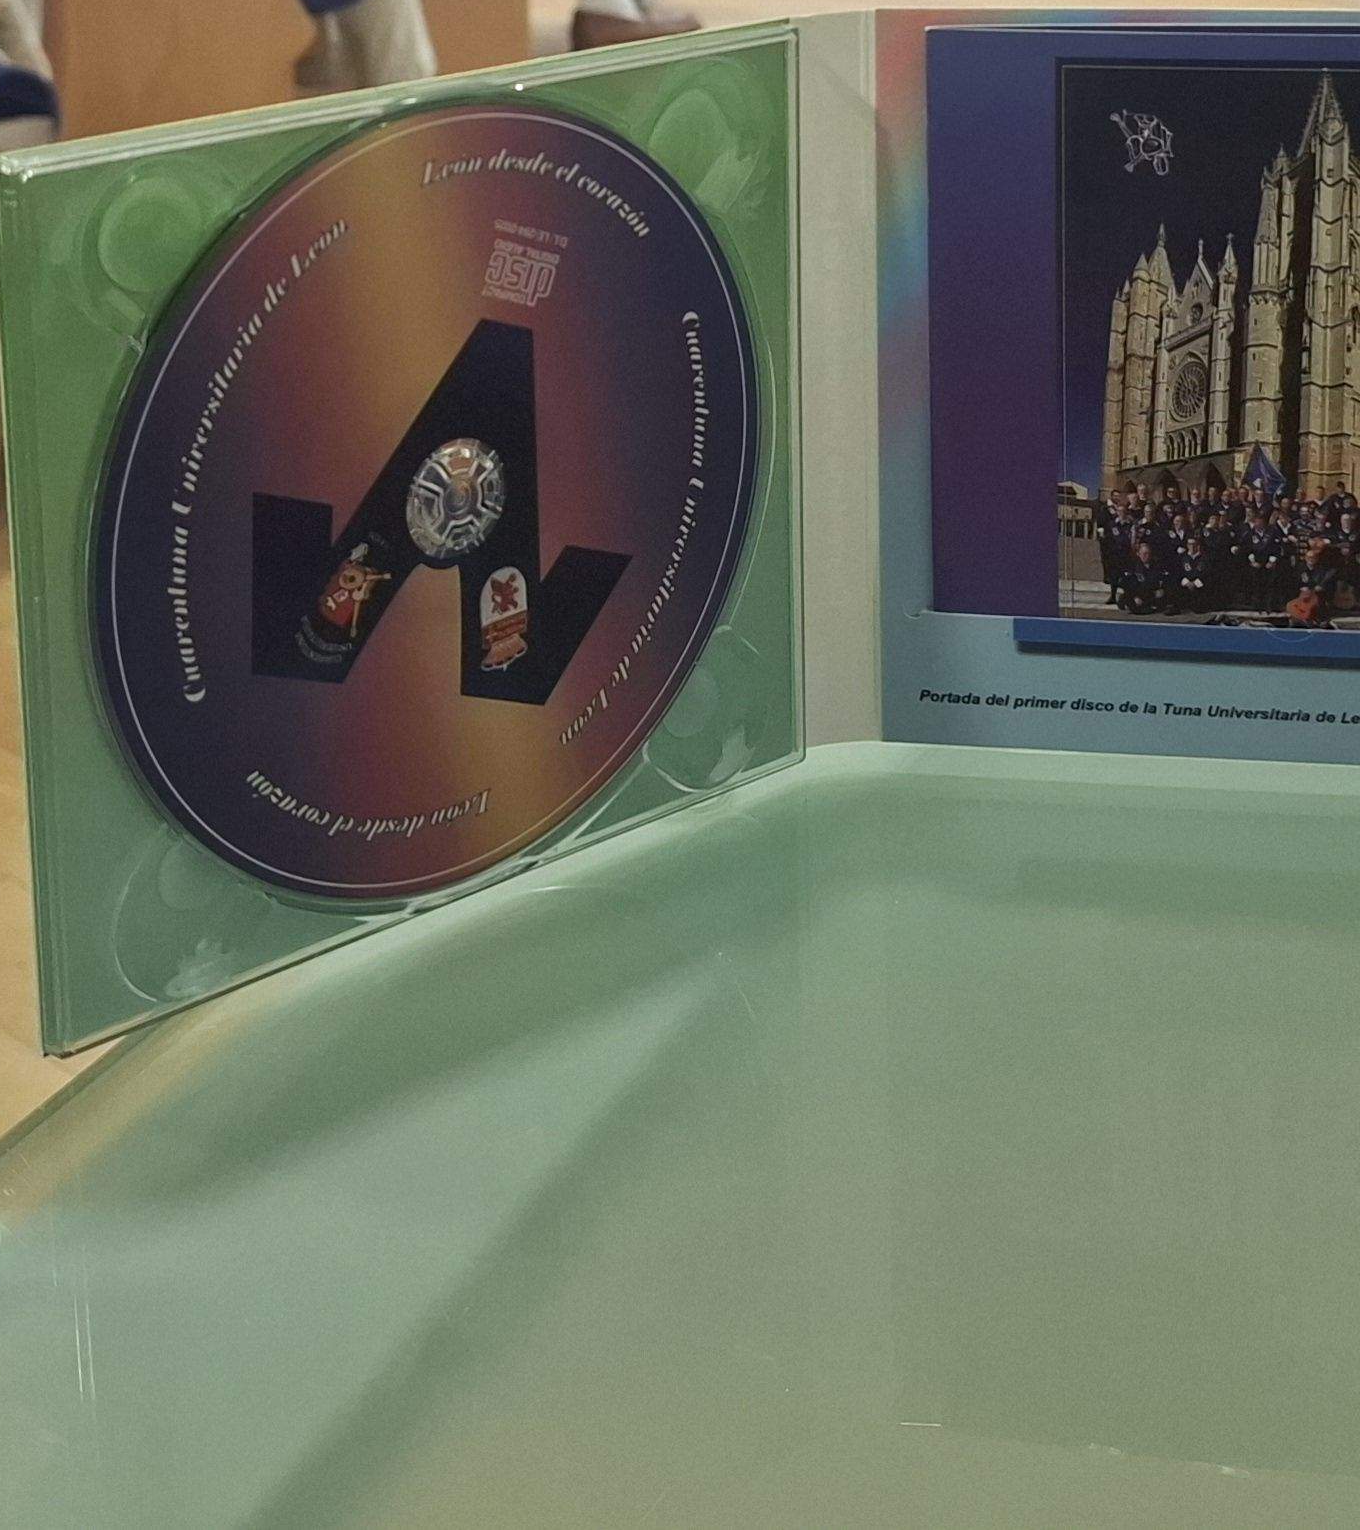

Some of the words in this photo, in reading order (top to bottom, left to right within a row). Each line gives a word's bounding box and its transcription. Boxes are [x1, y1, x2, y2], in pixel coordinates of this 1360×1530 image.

[489, 148, 553, 175] desde
[556, 163, 578, 182] el
[577, 176, 650, 237] corazón
[264, 278, 287, 312] de
[171, 313, 262, 514] Universitaria
[681, 311, 710, 468] Cuarentuna
[631, 478, 704, 654] Universitaria
[167, 526, 206, 702] Cuarentuna
[612, 655, 630, 687] de
[919, 689, 980, 706] Portada
[985, 693, 1009, 707] del
[1013, 696, 1067, 710] primer
[1070, 698, 1114, 713] disco
[1118, 700, 1139, 714] de
[1142, 702, 1158, 715] la
[1163, 703, 1202, 717] Tuna
[1207, 705, 1311, 723] Universitaria
[1315, 710, 1336, 724] de
[246, 770, 331, 825] corazón
[328, 815, 354, 836] el
[357, 815, 425, 841] desde
